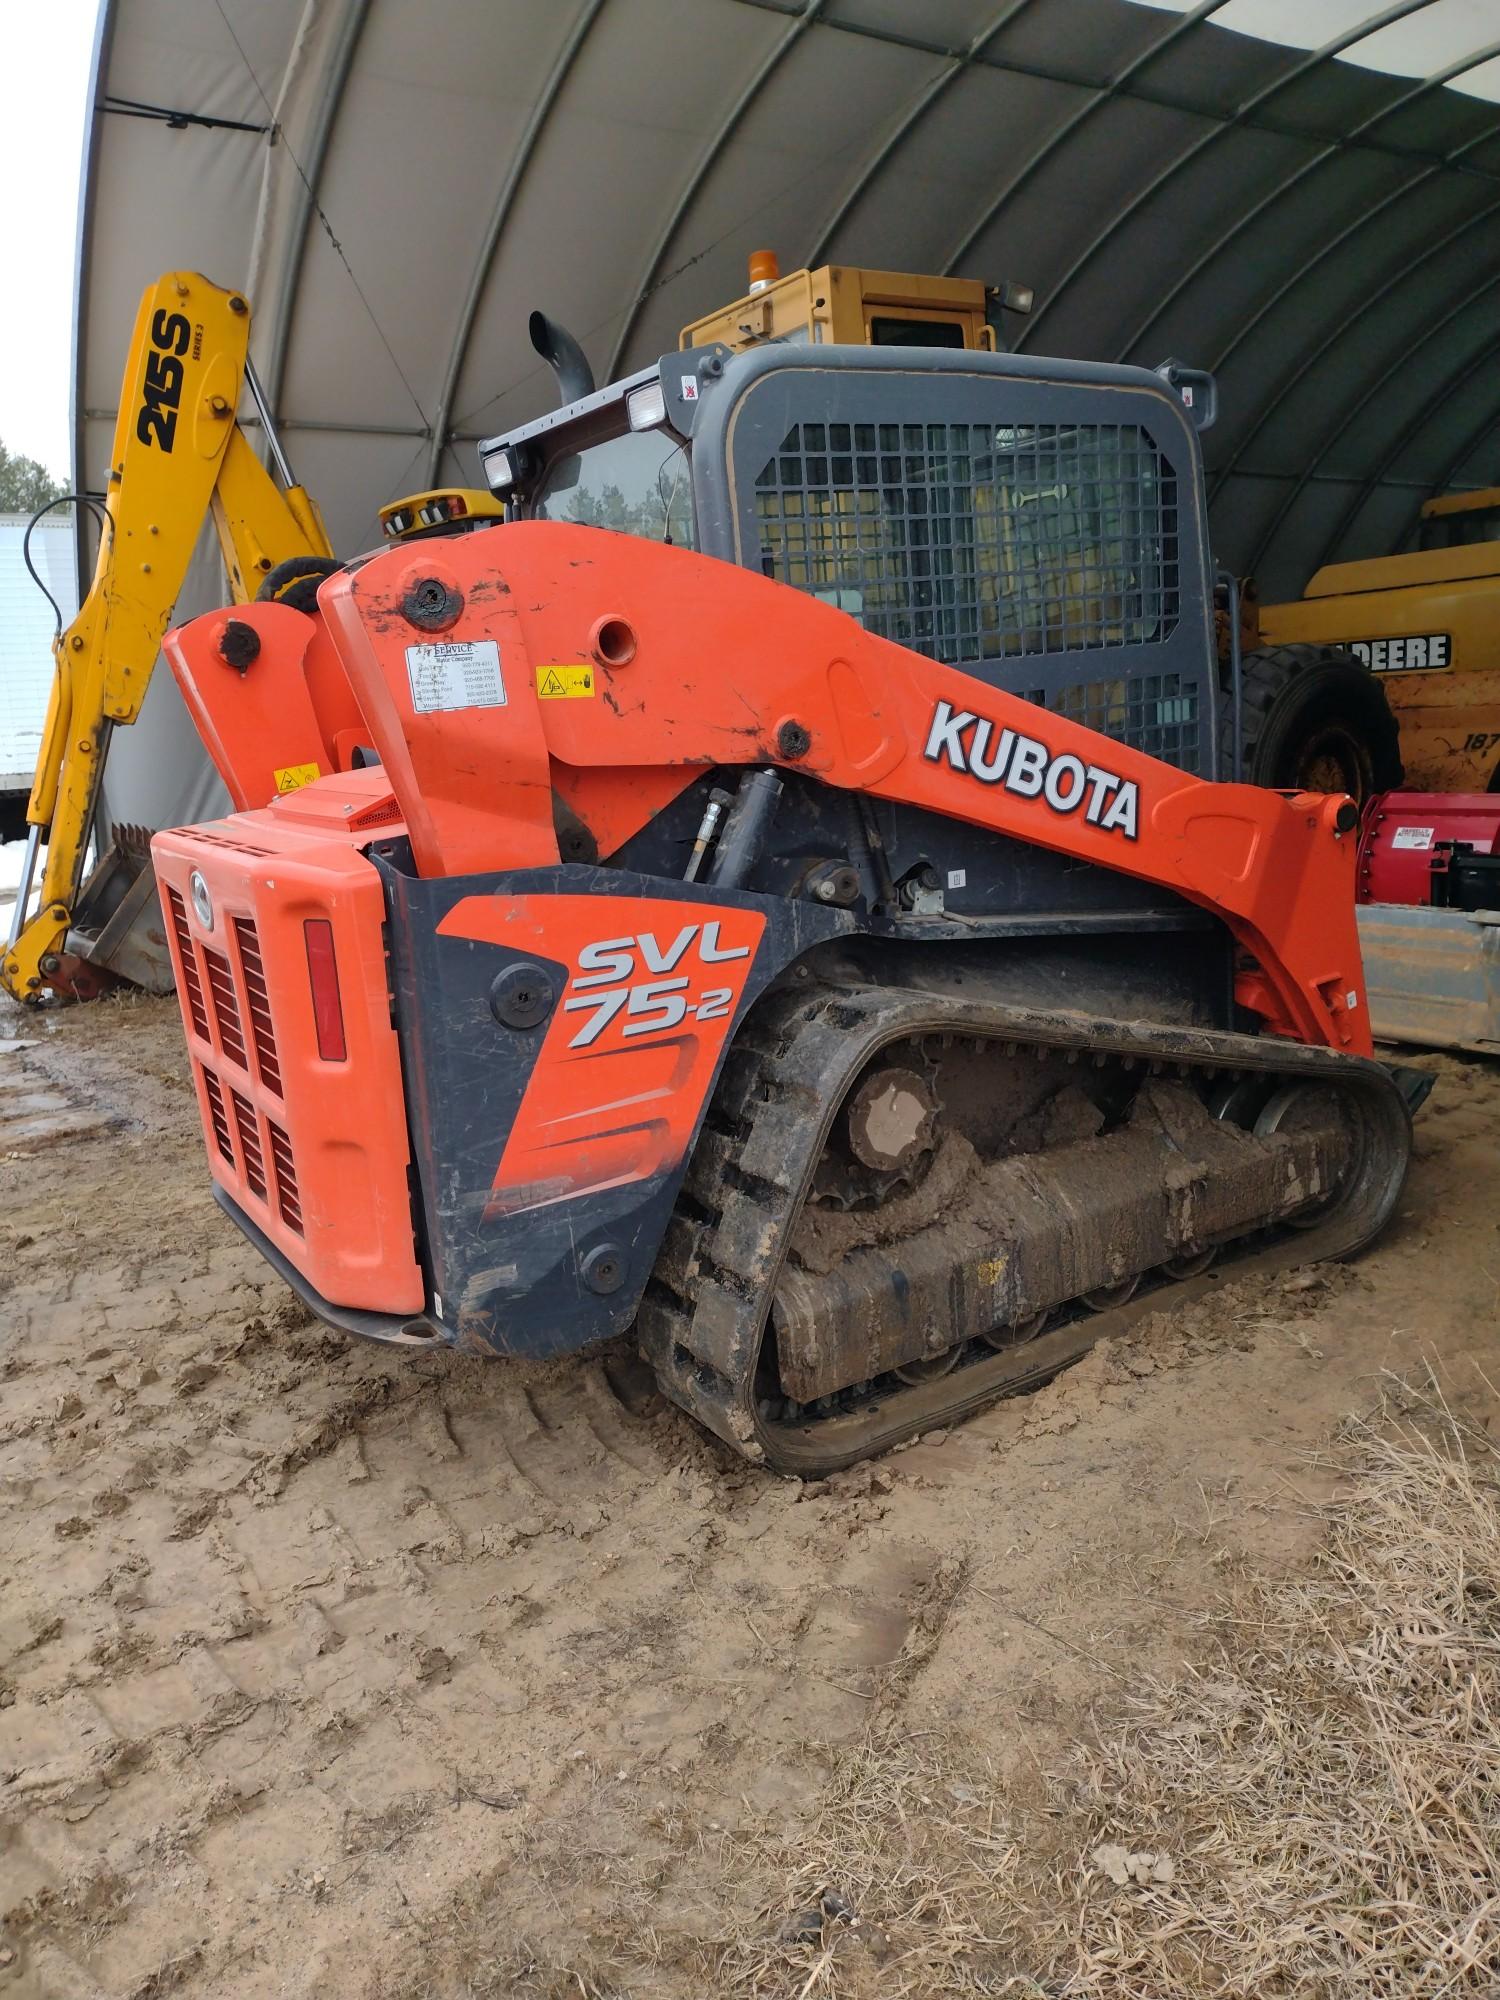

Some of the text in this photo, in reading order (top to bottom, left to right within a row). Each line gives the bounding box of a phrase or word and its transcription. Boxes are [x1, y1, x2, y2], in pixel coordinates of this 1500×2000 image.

[193, 331, 202, 361] SERIES
[137, 309, 191, 453] 215S
[434, 645, 473, 655] SERVICE
[1352, 636, 1447, 671] DEERE
[924, 700, 1138, 838] KUBOTA
[572, 921, 750, 989] SVL
[563, 976, 733, 1050] 75-2
